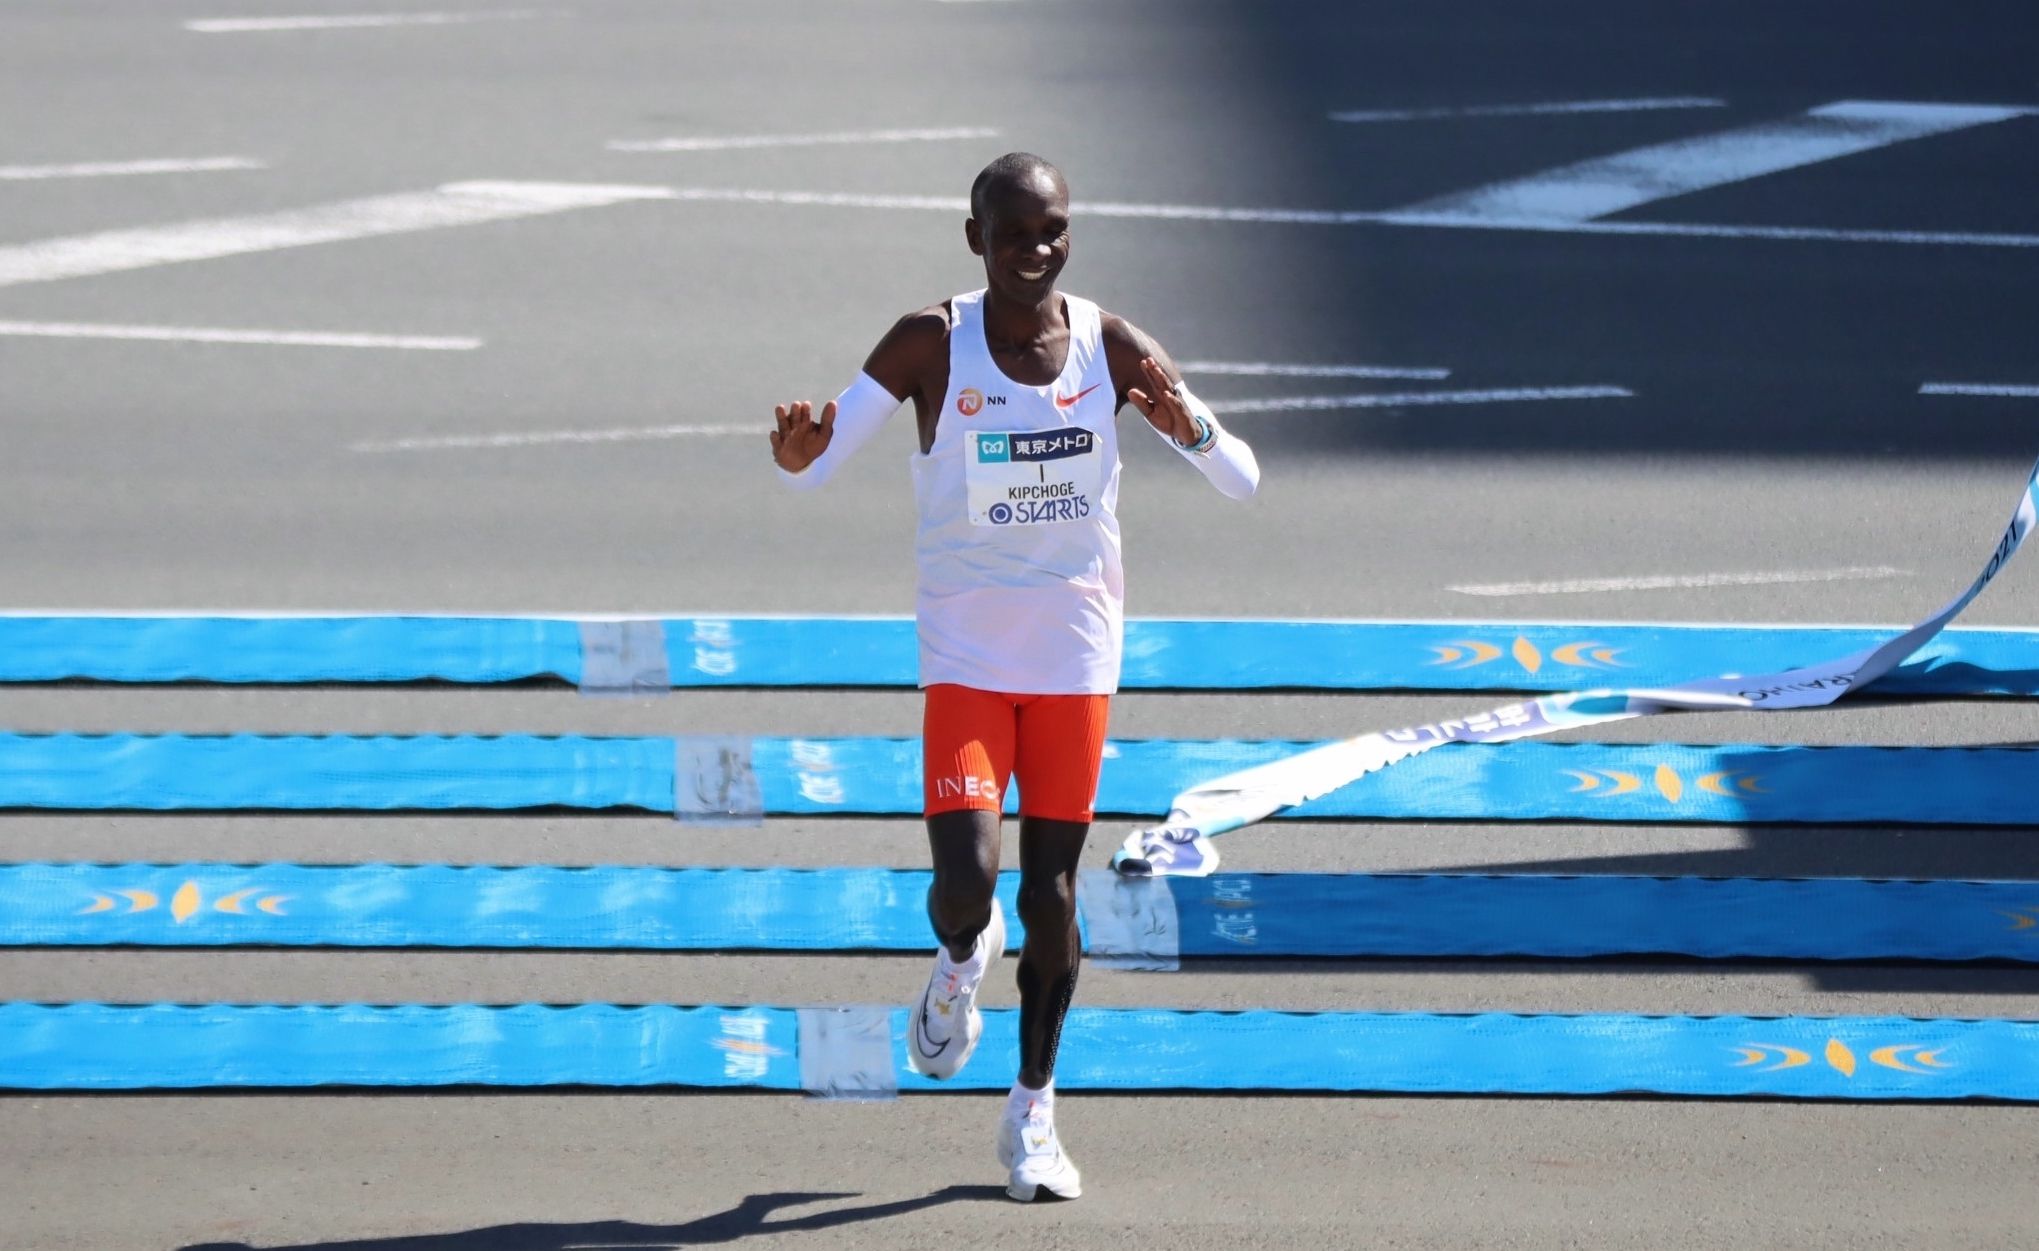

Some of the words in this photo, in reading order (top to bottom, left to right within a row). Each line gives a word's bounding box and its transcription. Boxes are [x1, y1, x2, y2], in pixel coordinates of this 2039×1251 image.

[987, 396, 1006, 405] NN
[1015, 434, 1089, 455] 東京メトロ
[1008, 481, 1075, 499] KIPCHOGE
[936, 775, 1000, 800] INEO
